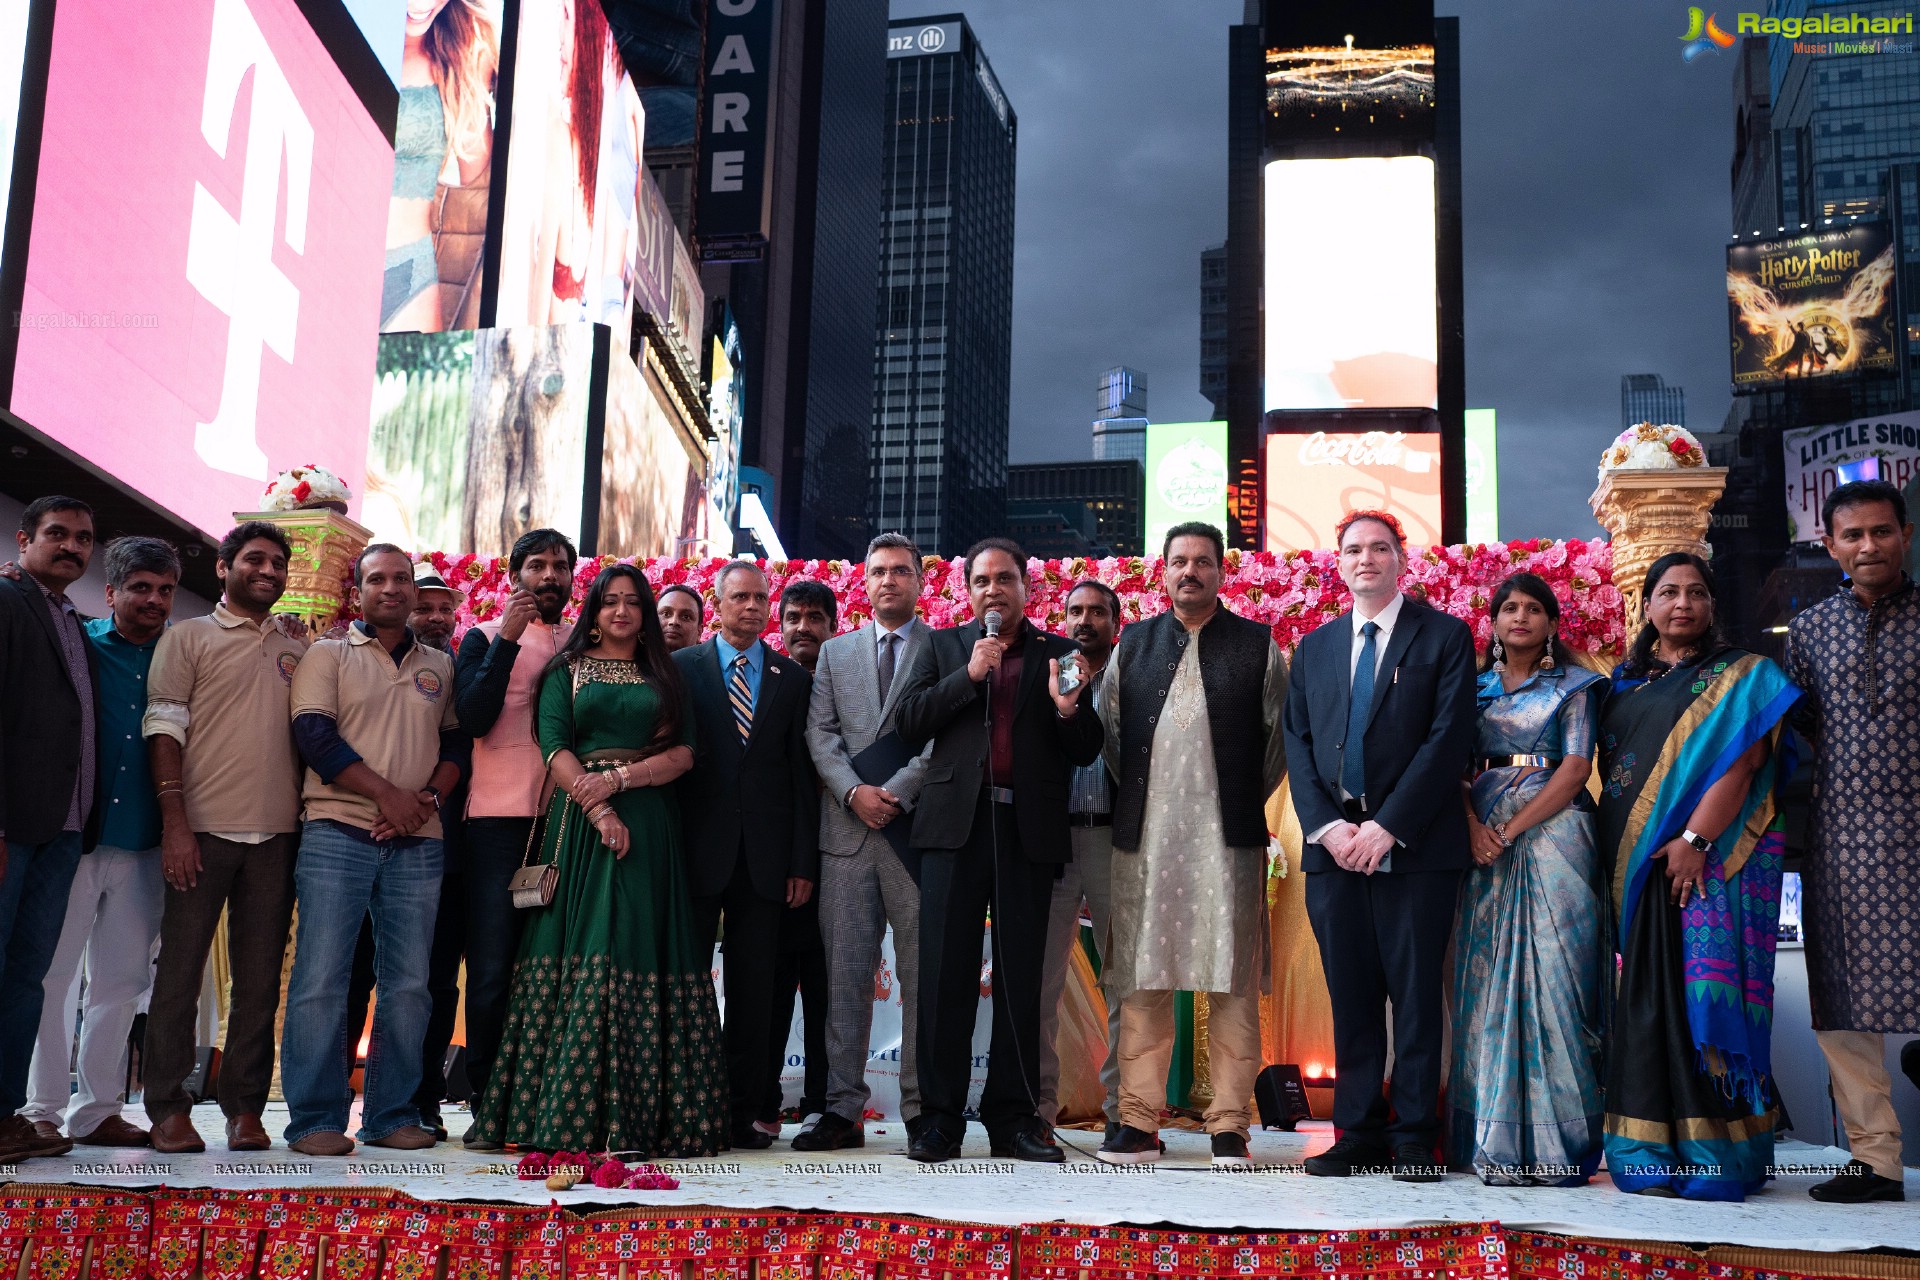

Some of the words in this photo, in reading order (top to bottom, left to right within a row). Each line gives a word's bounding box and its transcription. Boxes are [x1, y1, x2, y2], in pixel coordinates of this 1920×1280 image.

[1763, 242, 1782, 252] ON
[1787, 230, 1853, 249] BROADWAY
[1757, 255, 1808, 287] Harry
[1807, 247, 1861, 283] Potter
[1779, 279, 1813, 291] CURSED
[1814, 274, 1842, 286] CHILD
[1801, 424, 1870, 468] LITTLE
[1853, 450, 1868, 460] OF
